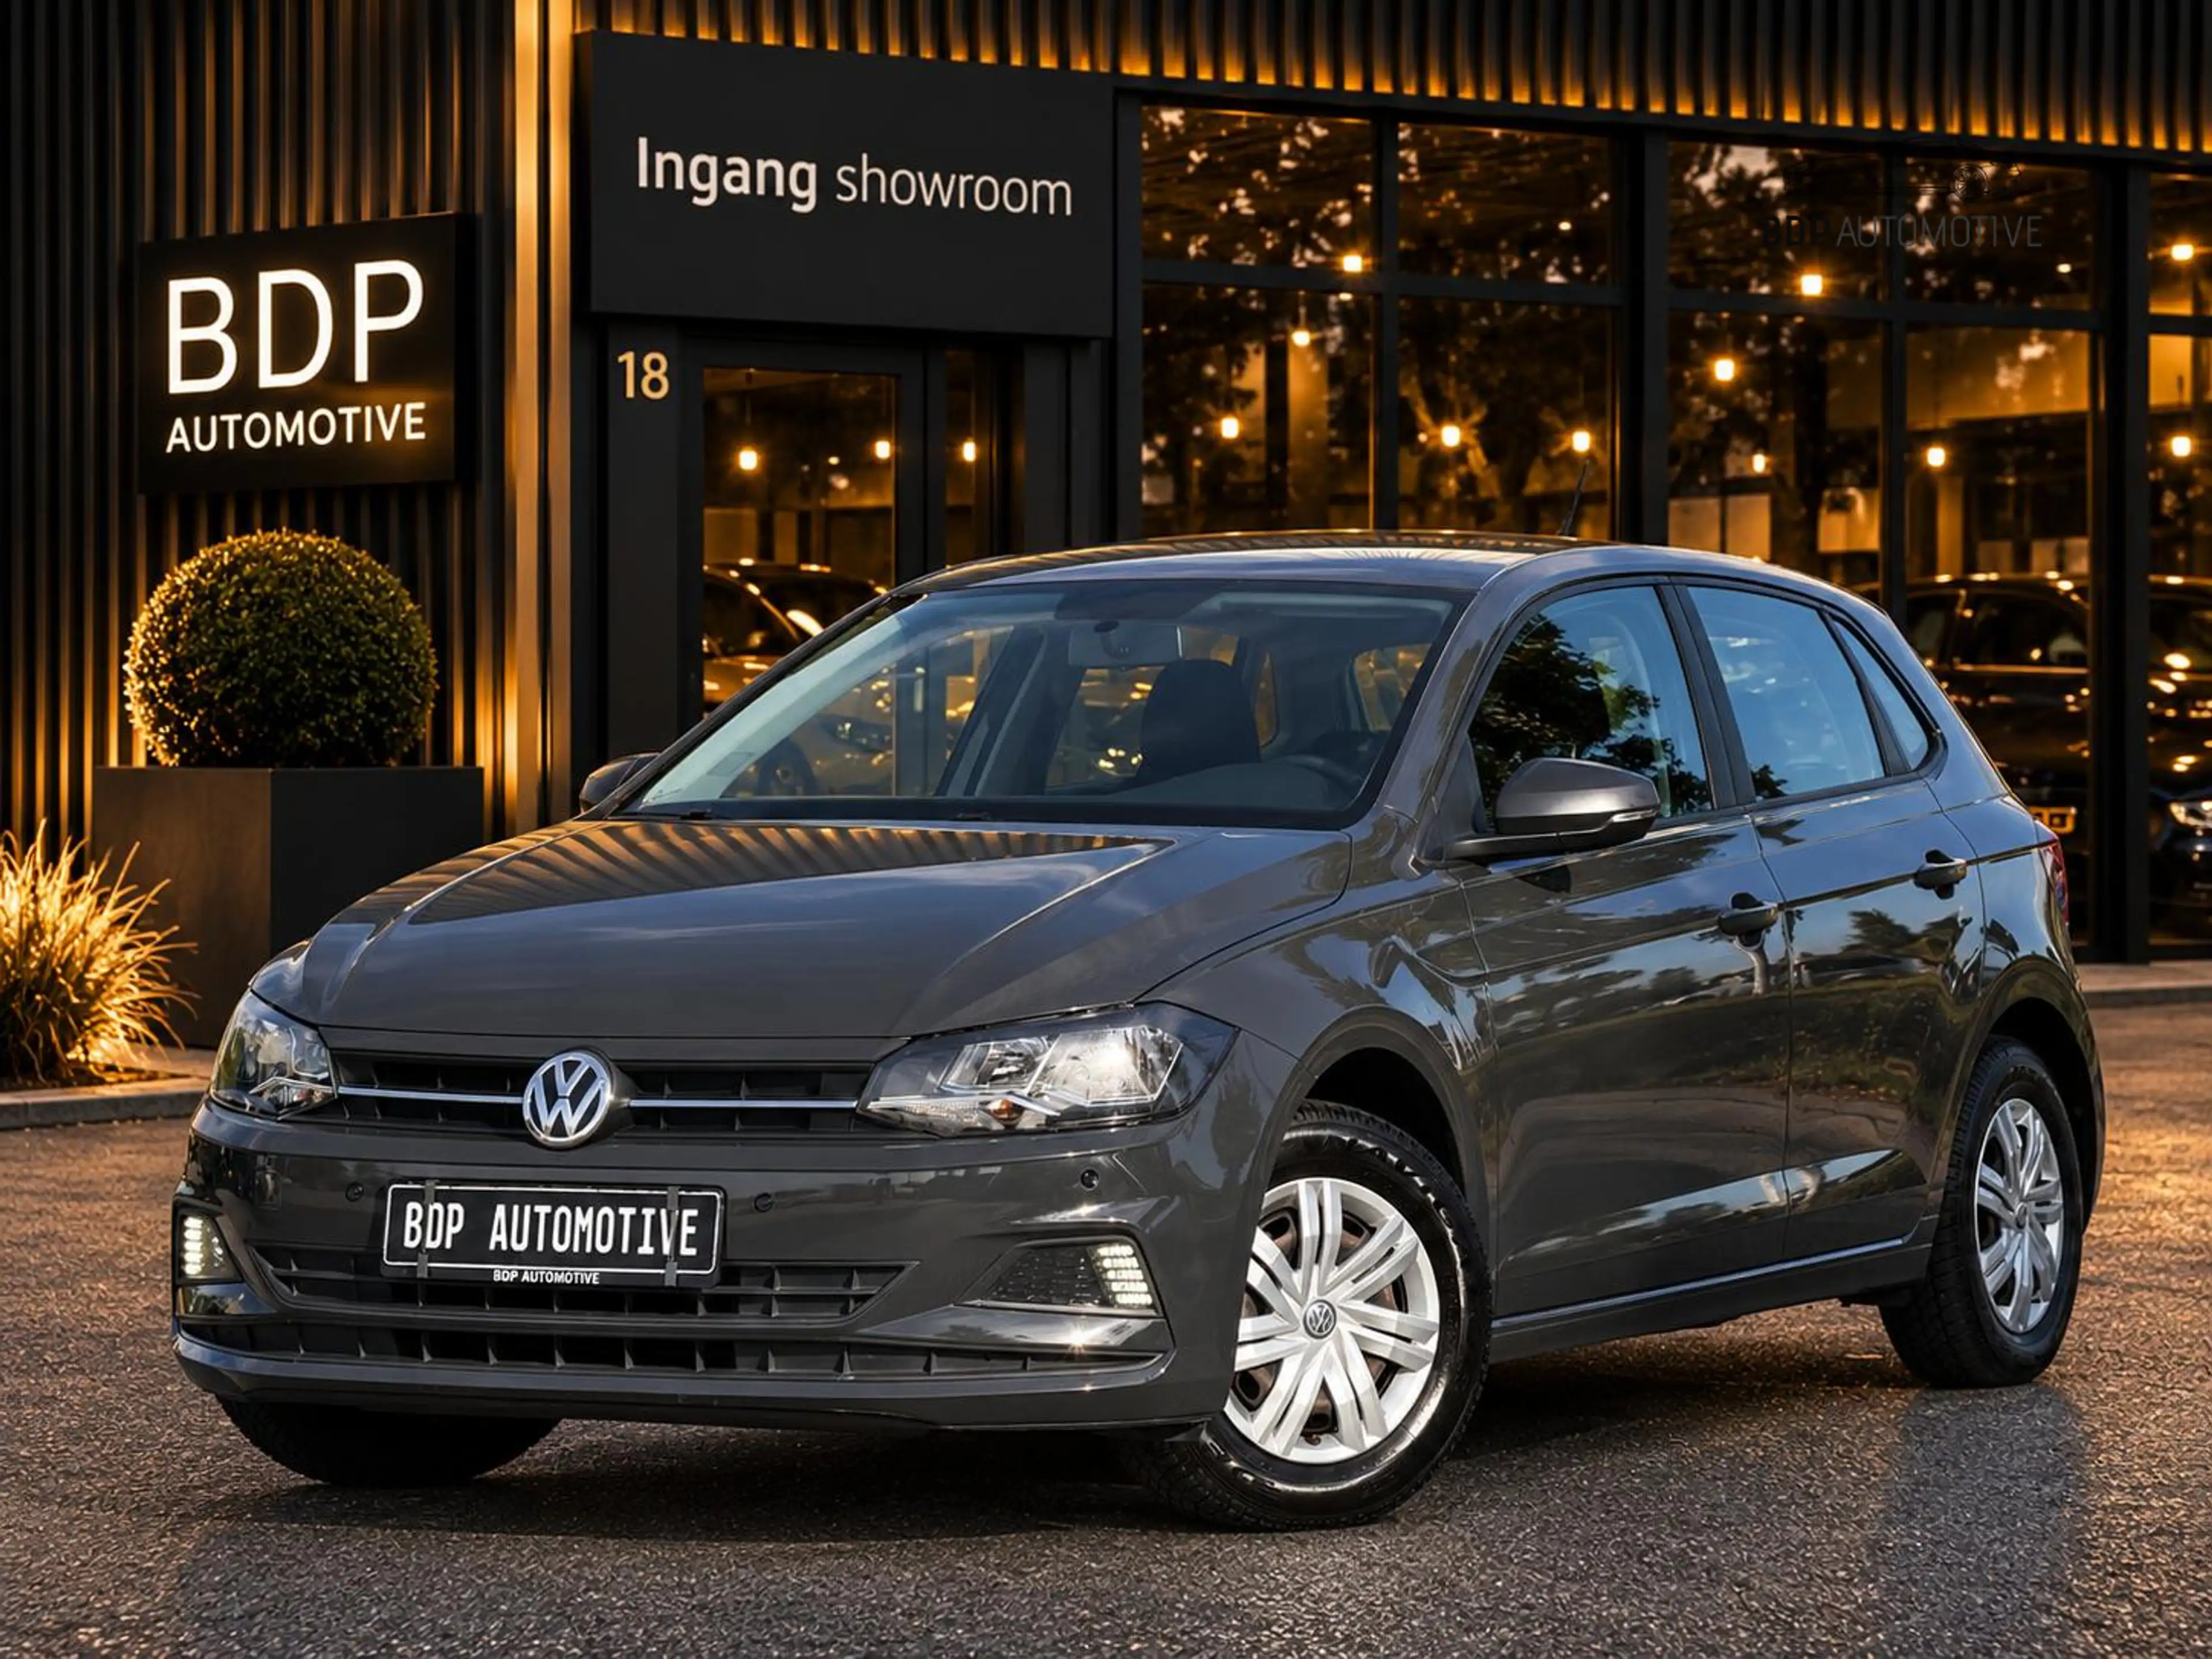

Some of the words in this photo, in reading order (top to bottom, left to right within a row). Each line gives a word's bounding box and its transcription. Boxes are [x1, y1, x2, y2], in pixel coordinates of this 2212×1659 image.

[638, 136, 817, 214] Ingang
[836, 152, 1072, 216] showroom
[168, 259, 424, 395] BDP
[617, 351, 669, 400] 18
[165, 401, 426, 453] AUTOMOTIVE
[403, 1201, 465, 1249] BDP
[488, 1203, 699, 1256] AUTOMOTIVE
[493, 1268, 520, 1283] BDP
[521, 1269, 600, 1285] AUTOMOTIVE
